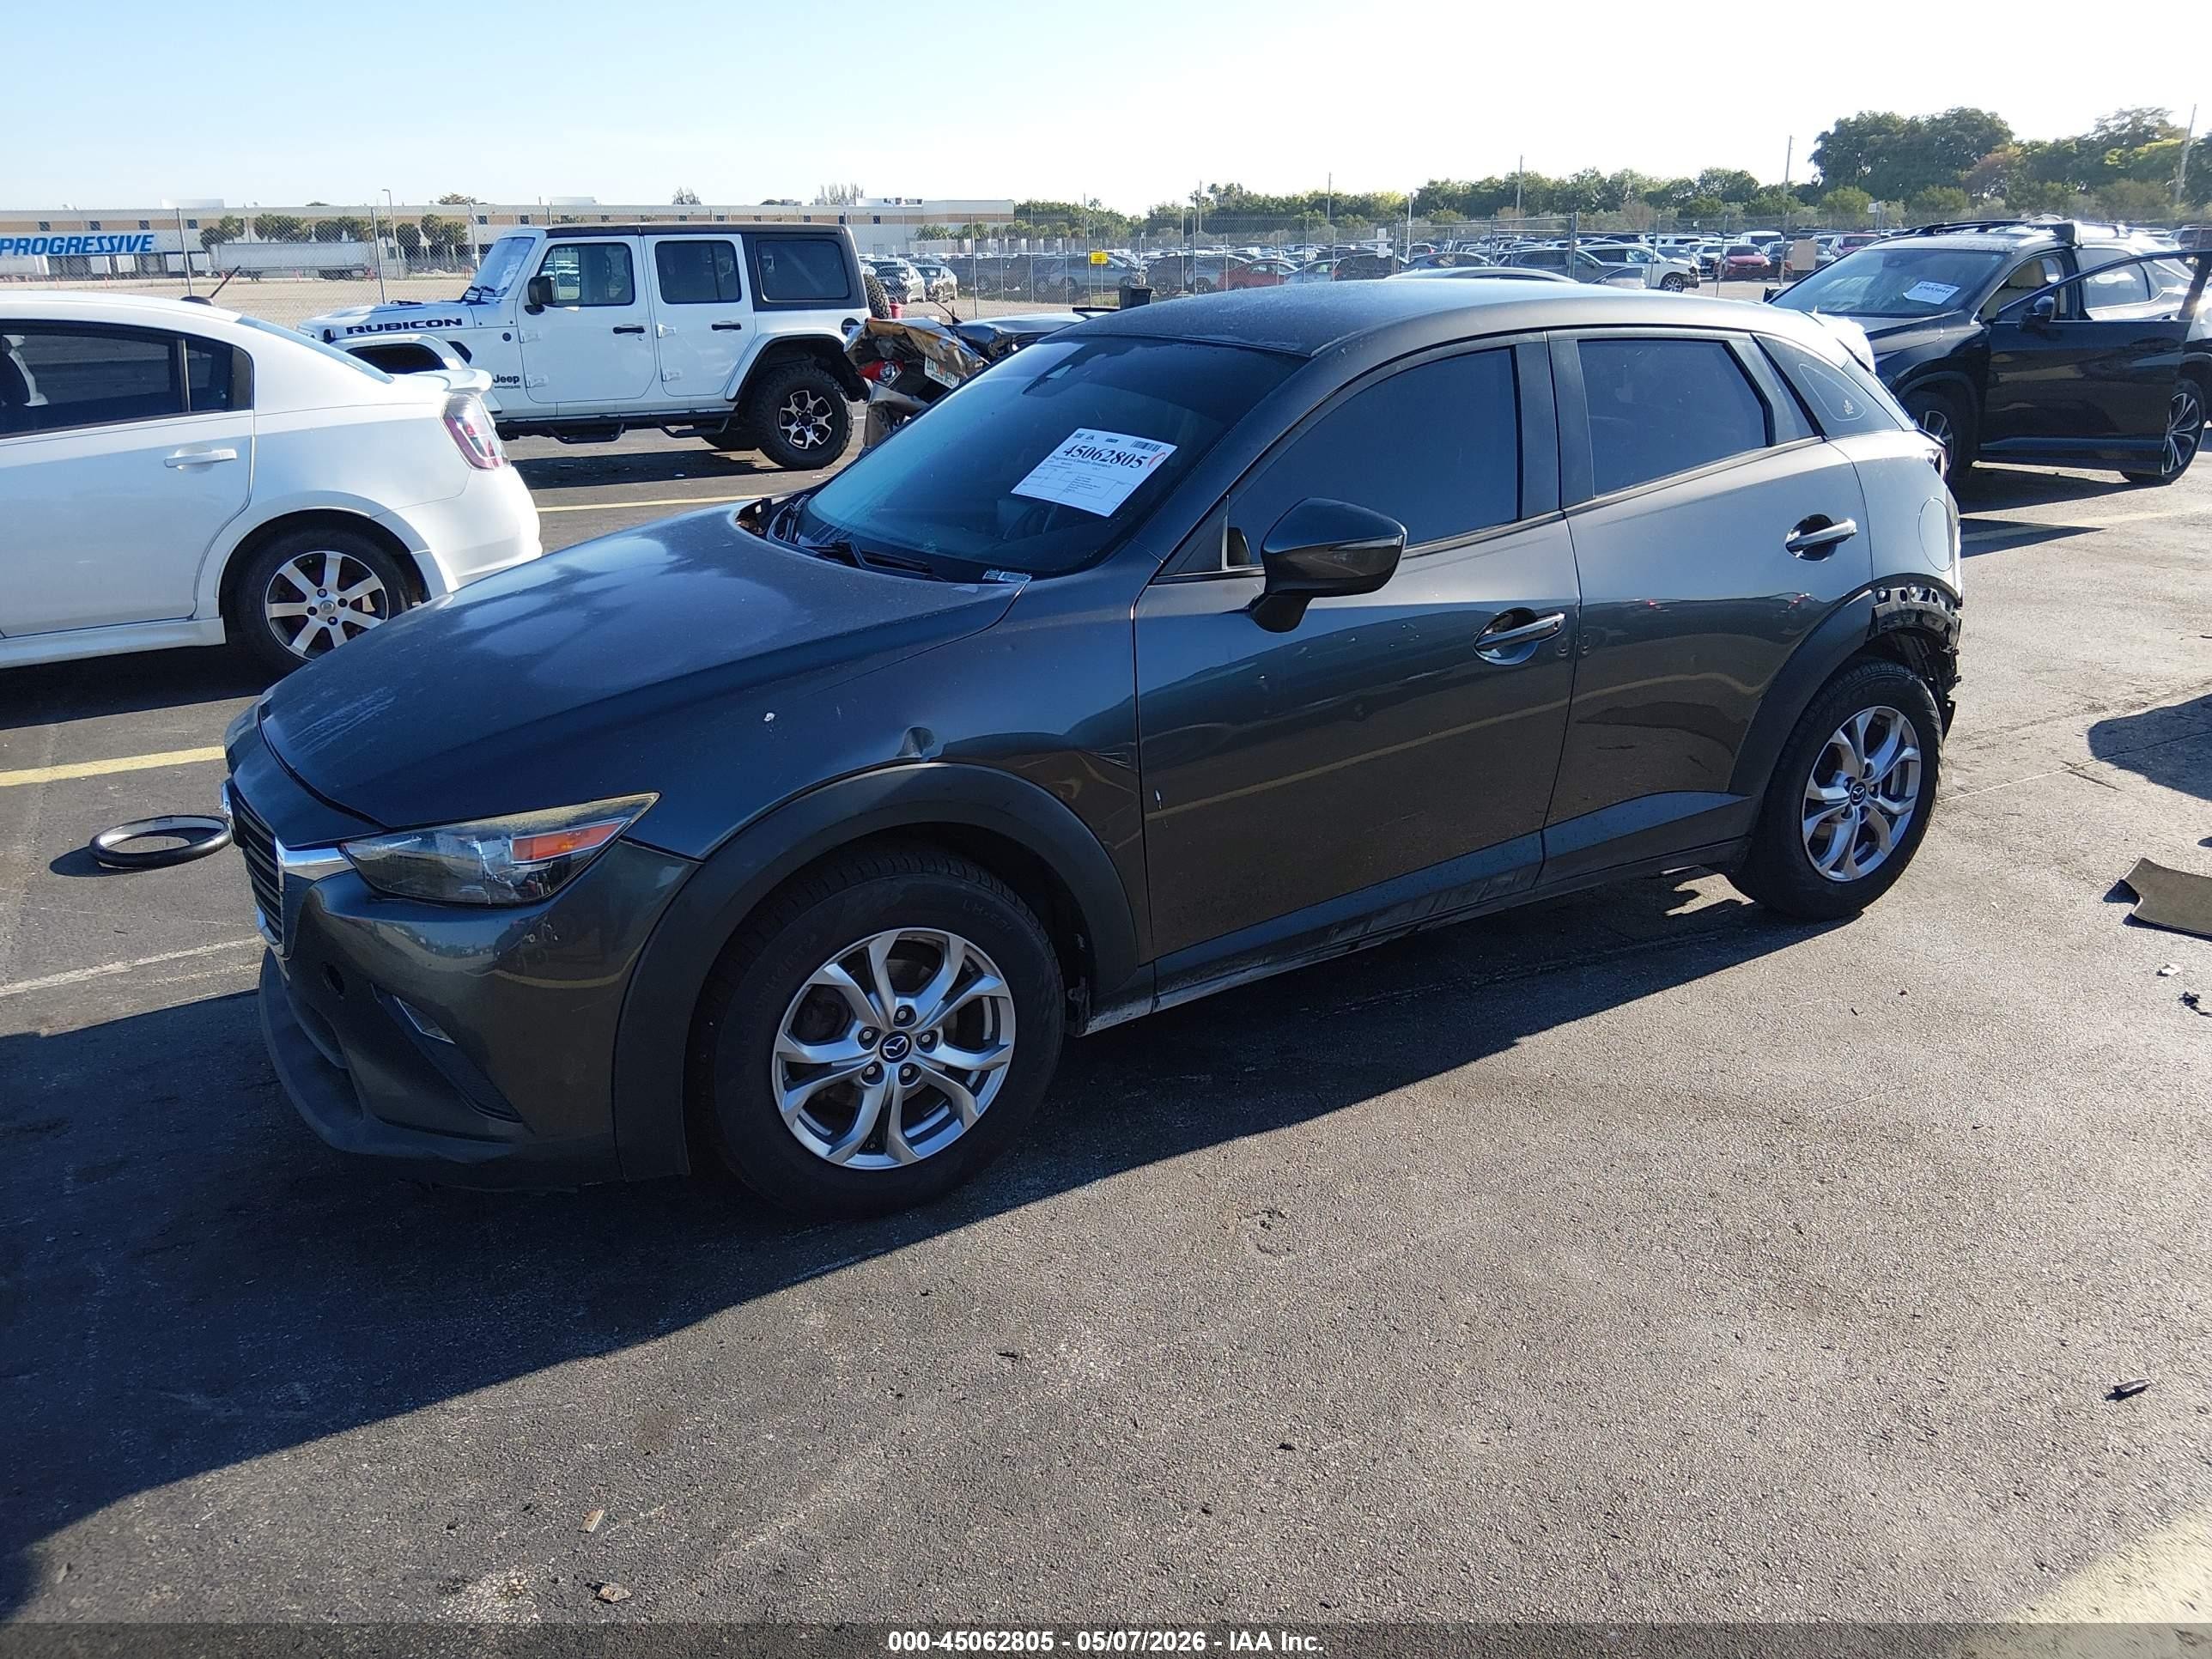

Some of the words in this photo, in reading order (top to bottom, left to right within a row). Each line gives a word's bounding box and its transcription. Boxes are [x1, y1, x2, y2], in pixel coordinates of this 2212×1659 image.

[0, 234, 155, 256] PROGRESSIVE
[345, 318, 463, 335] RUBICON
[493, 374, 520, 385] Jeep
[1063, 444, 1149, 469] 45062805
